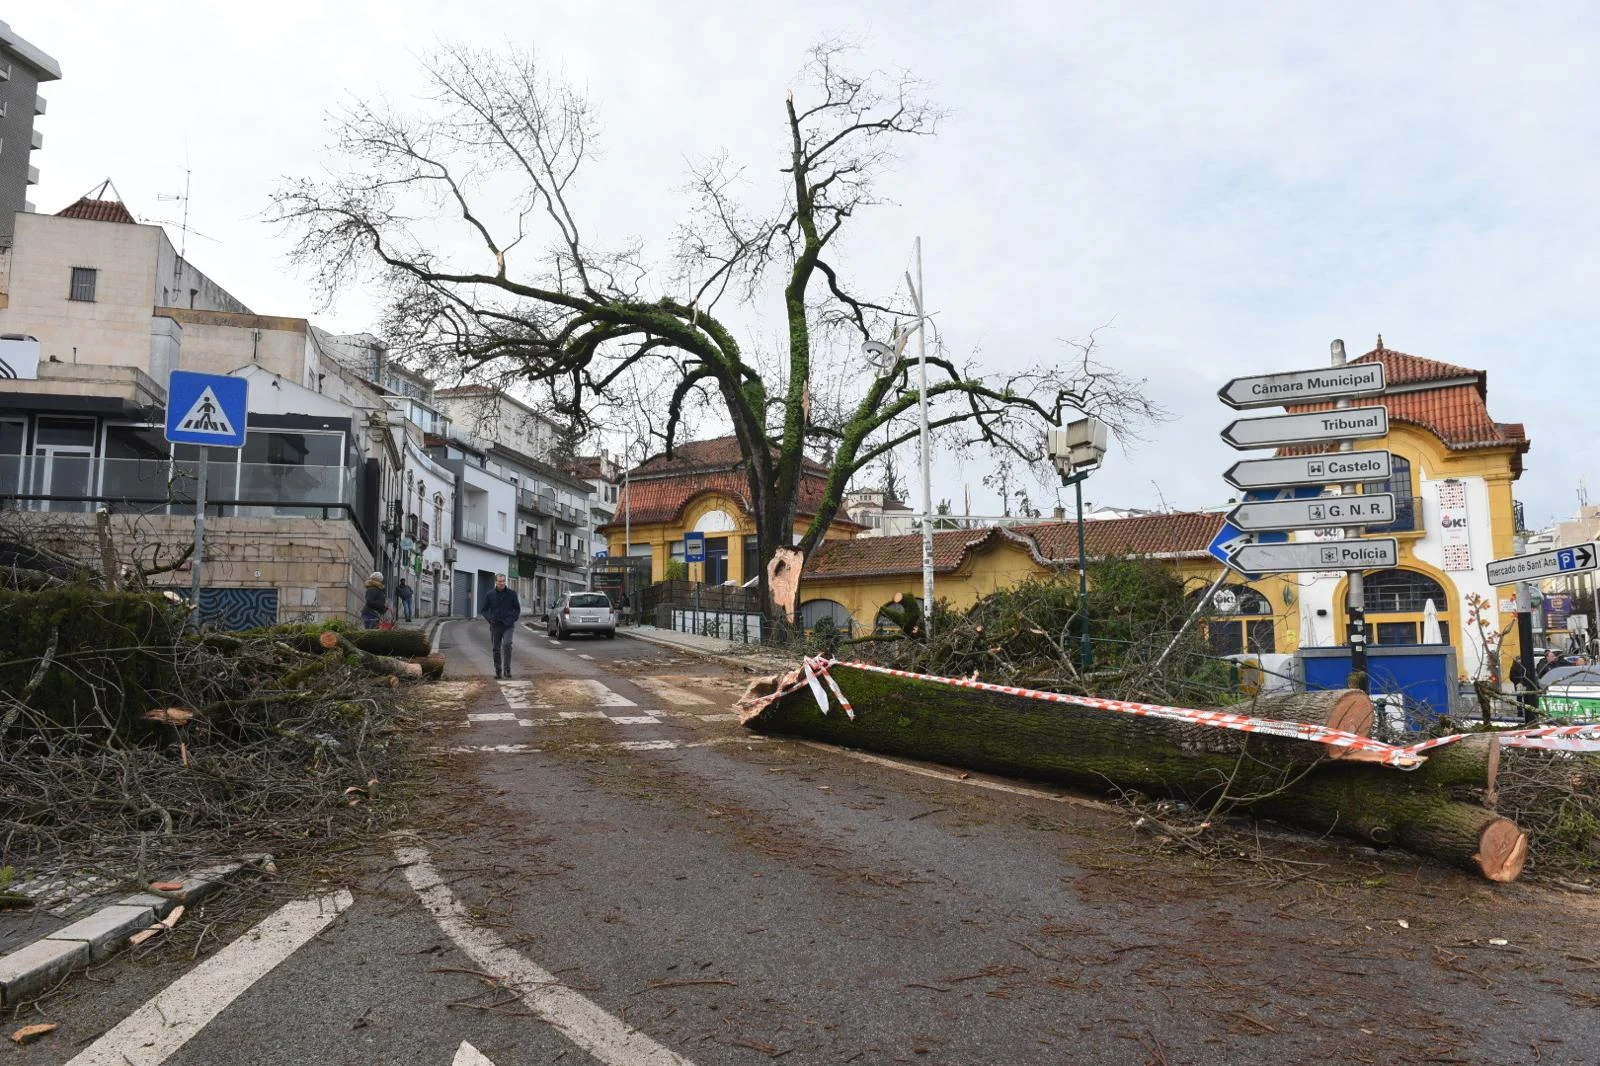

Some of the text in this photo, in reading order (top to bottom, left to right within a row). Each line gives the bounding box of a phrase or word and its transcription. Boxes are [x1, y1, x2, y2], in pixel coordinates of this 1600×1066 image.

[1252, 372, 1375, 395] Câmara Municipal
[1321, 415, 1378, 431] Tribunal
[1328, 460, 1381, 474] Castelo
[1342, 548, 1388, 561] Polícia
[1489, 563, 1516, 577] mercado
[1517, 563, 1526, 573] de
